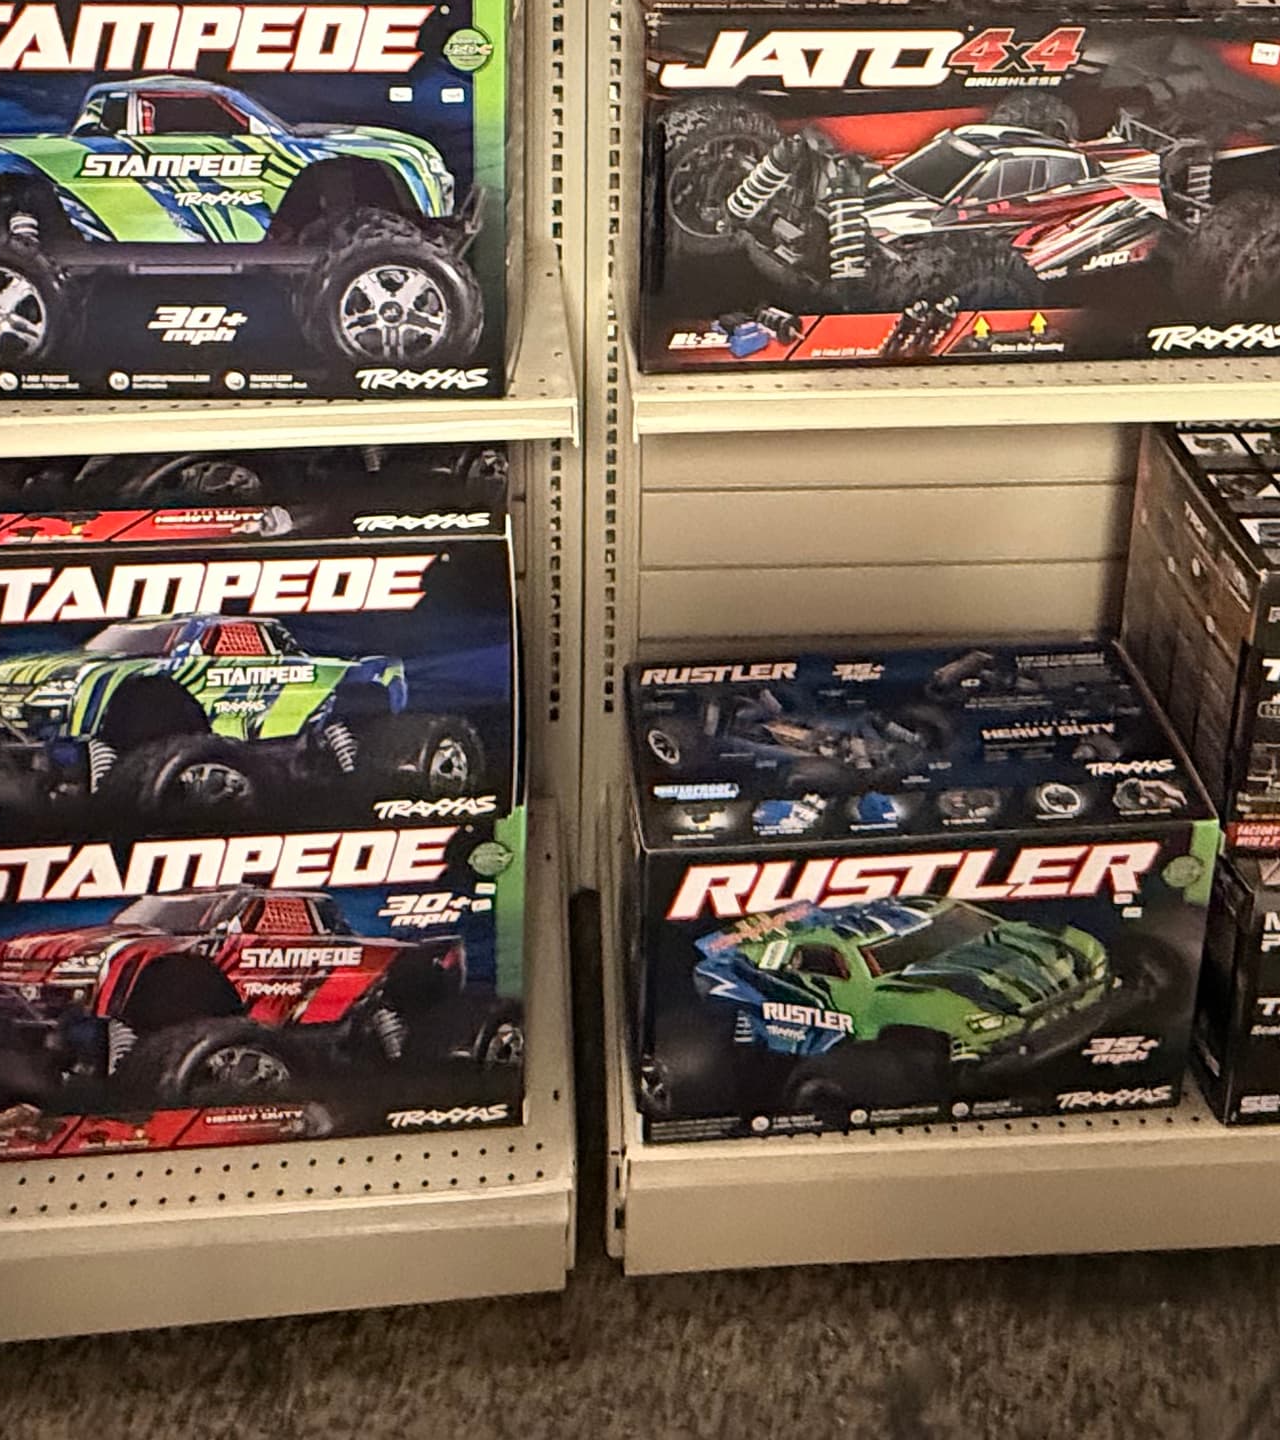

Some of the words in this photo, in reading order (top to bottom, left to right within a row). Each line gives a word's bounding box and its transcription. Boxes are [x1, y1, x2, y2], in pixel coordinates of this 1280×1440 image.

[660, 29, 967, 89] JATO
[964, 75, 1062, 87] BRUSHLESS
[81, 153, 268, 178] STAMPEDE
[174, 189, 263, 207] TRAXXAS
[1083, 250, 1129, 272] JATO
[146, 306, 248, 330] 30+
[164, 327, 238, 346] mph
[355, 367, 489, 390] TRAXXAS
[353, 511, 491, 533] TRAXXAS
[206, 664, 316, 687] STAMPEDE
[641, 663, 798, 686] RUSTLER
[214, 698, 266, 713] TRAXXAS
[982, 724, 1057, 741] HEAVY
[1061, 720, 1116, 736] DUTY
[1086, 758, 1177, 777] TRAXXAS
[373, 796, 497, 819] TRAXXAS
[666, 841, 1163, 922] RUSTLER
[378, 891, 474, 918] 30+
[391, 910, 462, 929] mph
[239, 945, 363, 969] STAMPEDE
[243, 981, 302, 997] TRAXXAS
[762, 1001, 853, 1034] RUSTLER
[1081, 1036, 1160, 1057] 35+
[1089, 1050, 1150, 1065] mph
[1056, 1085, 1173, 1109] TRAXXAS
[387, 1103, 509, 1129] TRAXXAS
